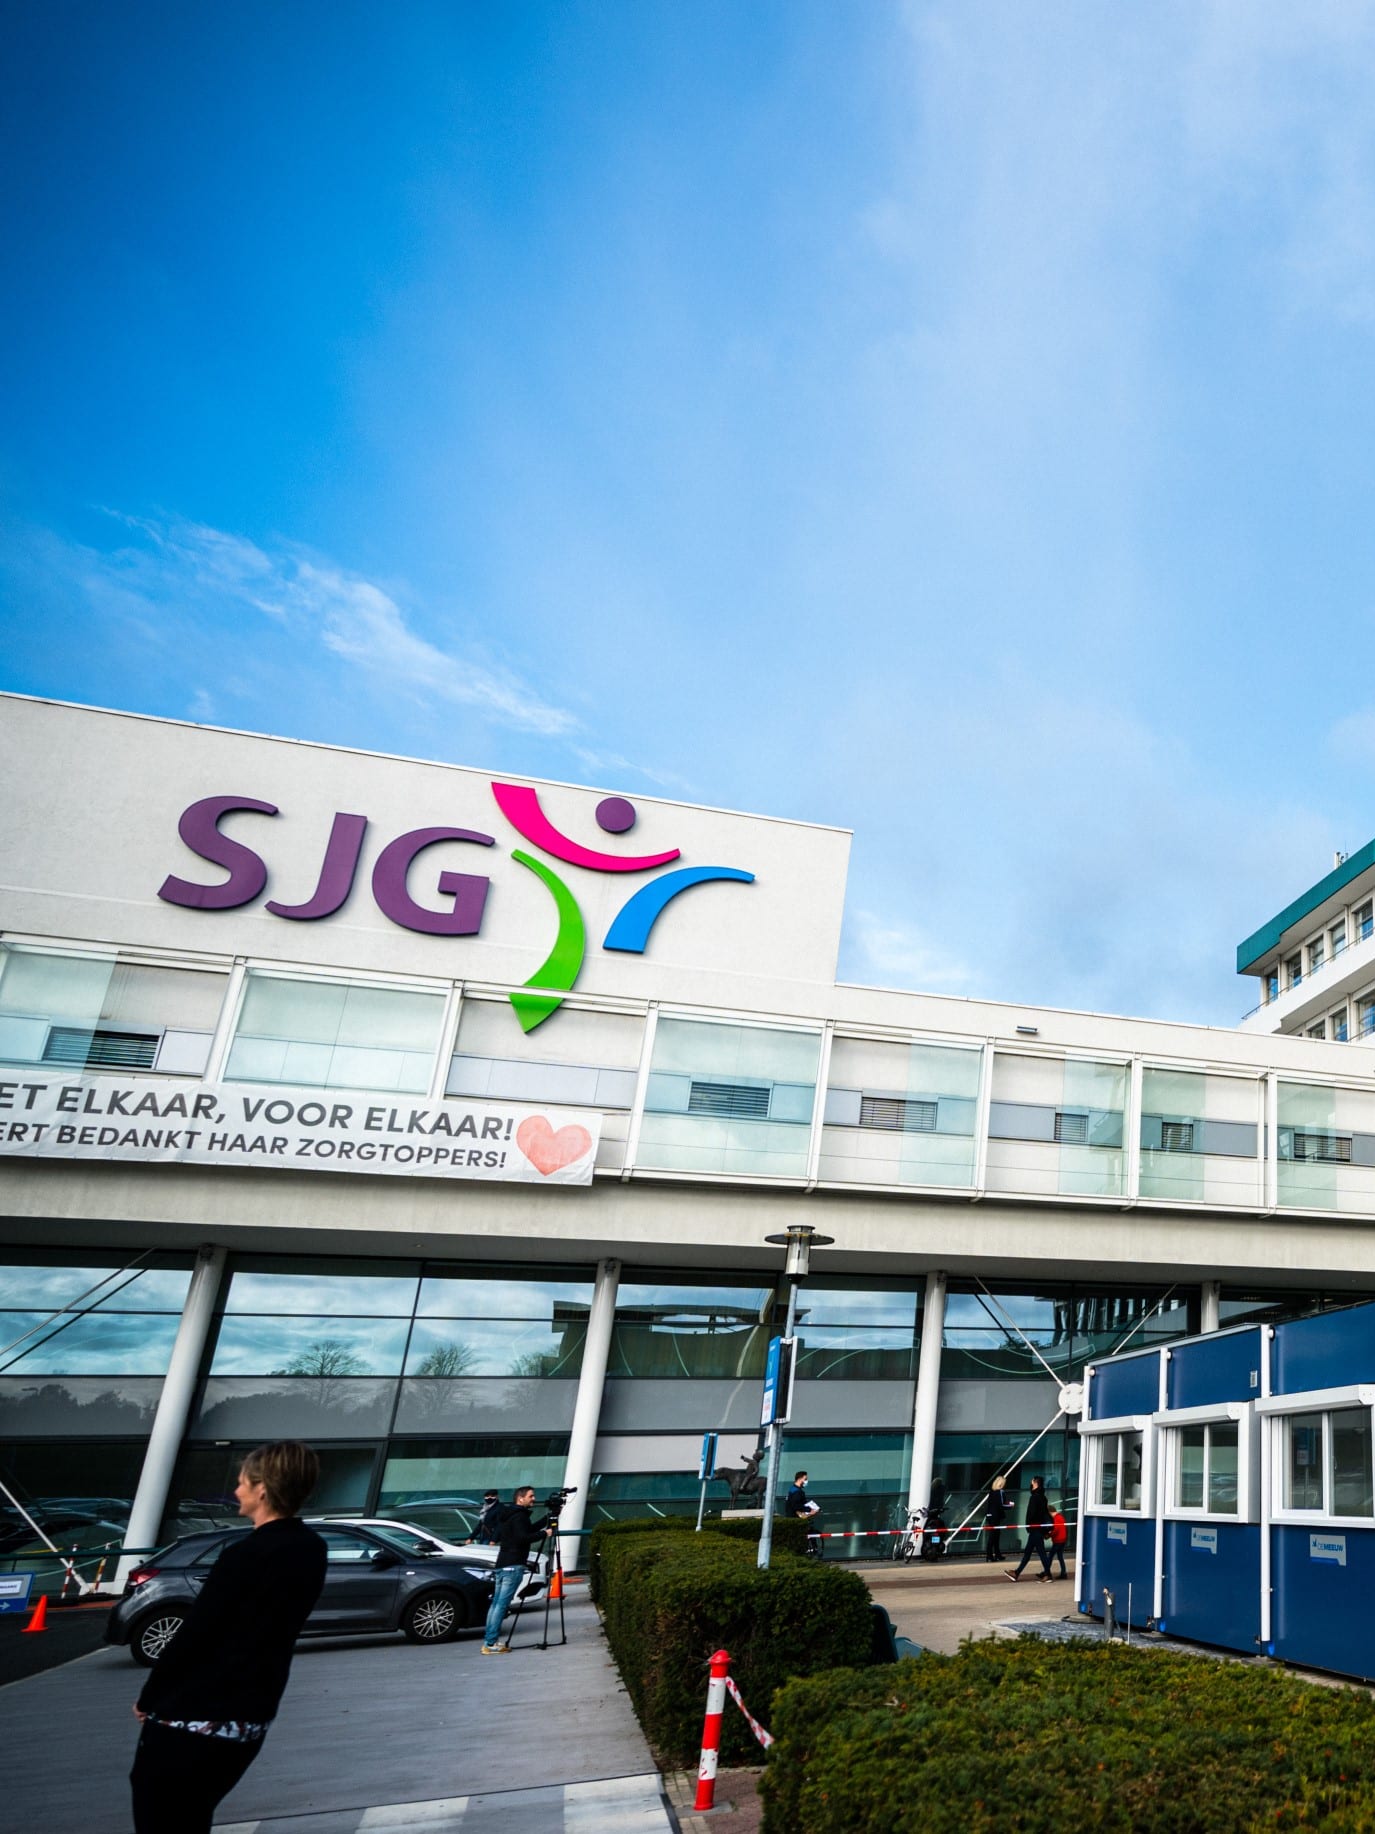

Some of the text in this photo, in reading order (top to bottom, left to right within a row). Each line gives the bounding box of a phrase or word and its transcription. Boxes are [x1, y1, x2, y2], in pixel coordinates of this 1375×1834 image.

[157, 796, 496, 937] SJG
[56, 1086, 226, 1124] ELKAAR,
[243, 1097, 352, 1129] VOOR
[364, 1107, 514, 1141] ELKAAR!
[56, 1124, 201, 1149] BEDANKT
[207, 1132, 288, 1155] HAAR
[295, 1138, 507, 1168] ZORGTOPPERS!
